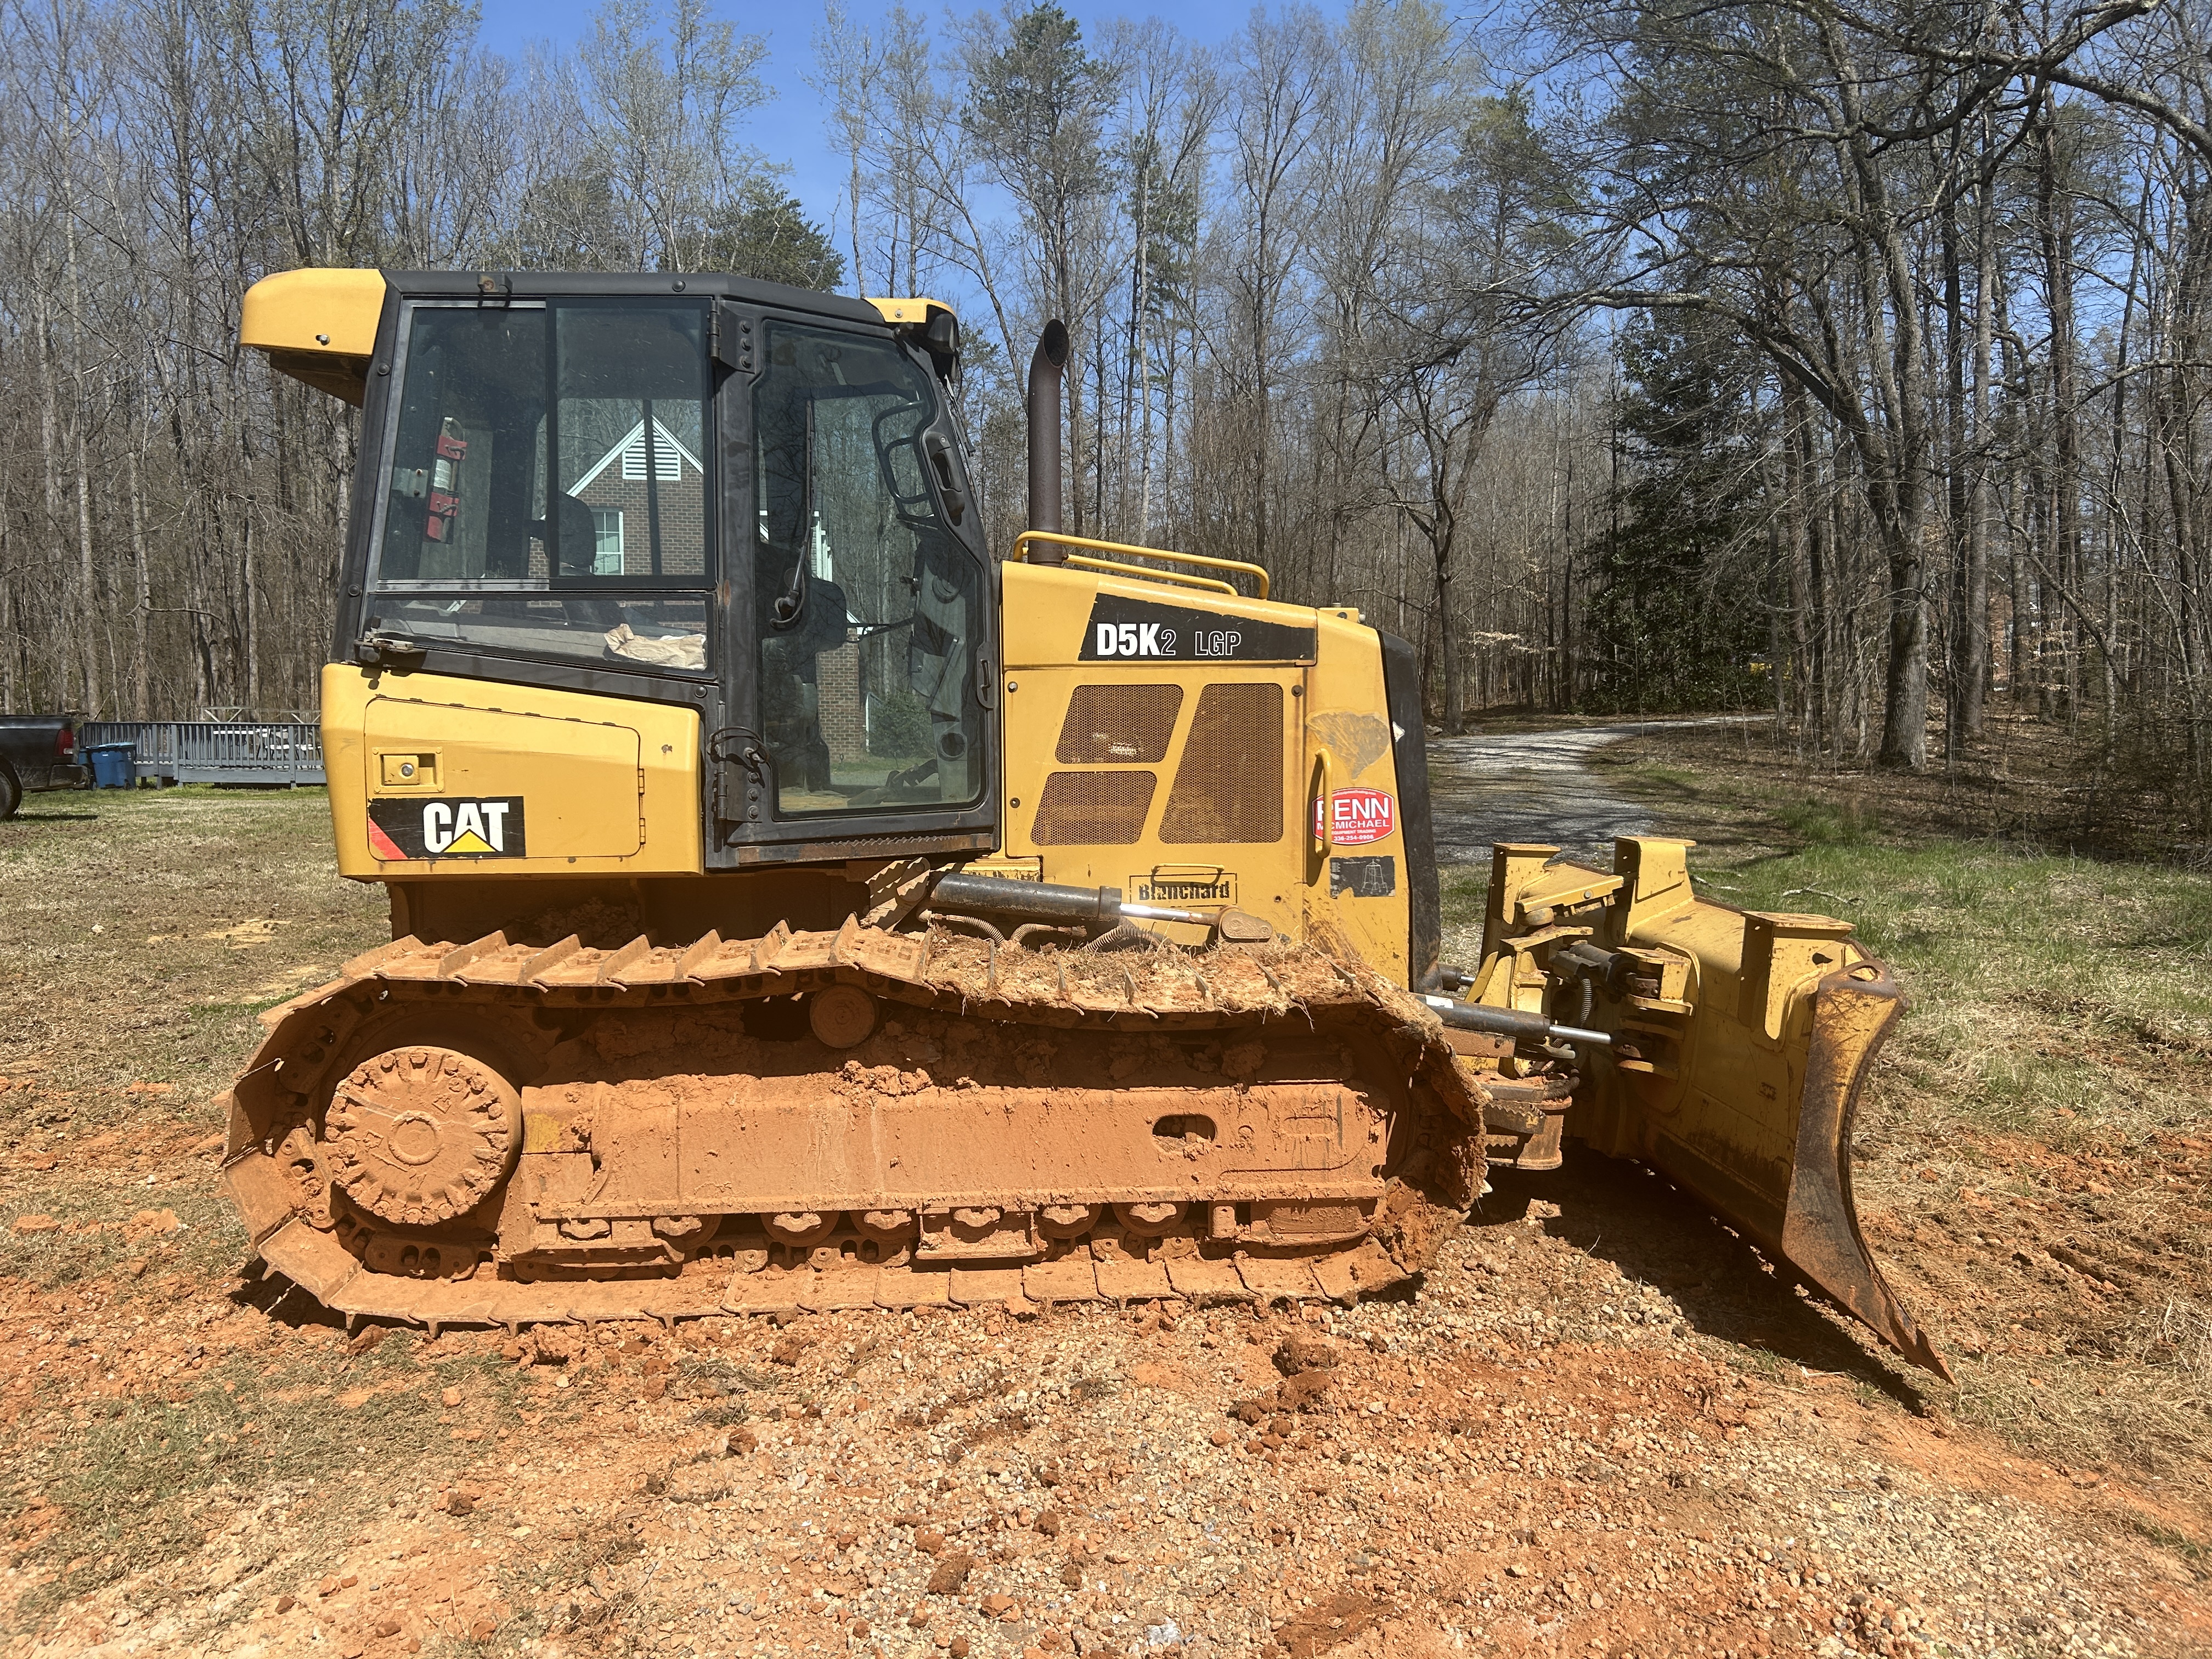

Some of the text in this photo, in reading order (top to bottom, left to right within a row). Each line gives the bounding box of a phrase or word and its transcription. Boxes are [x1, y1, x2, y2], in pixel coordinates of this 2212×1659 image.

[1195, 631, 1242, 656] LGP
[1317, 797, 1389, 821] PENN
[423, 802, 510, 853] CAT
[1139, 881, 1229, 900] Blanchard
